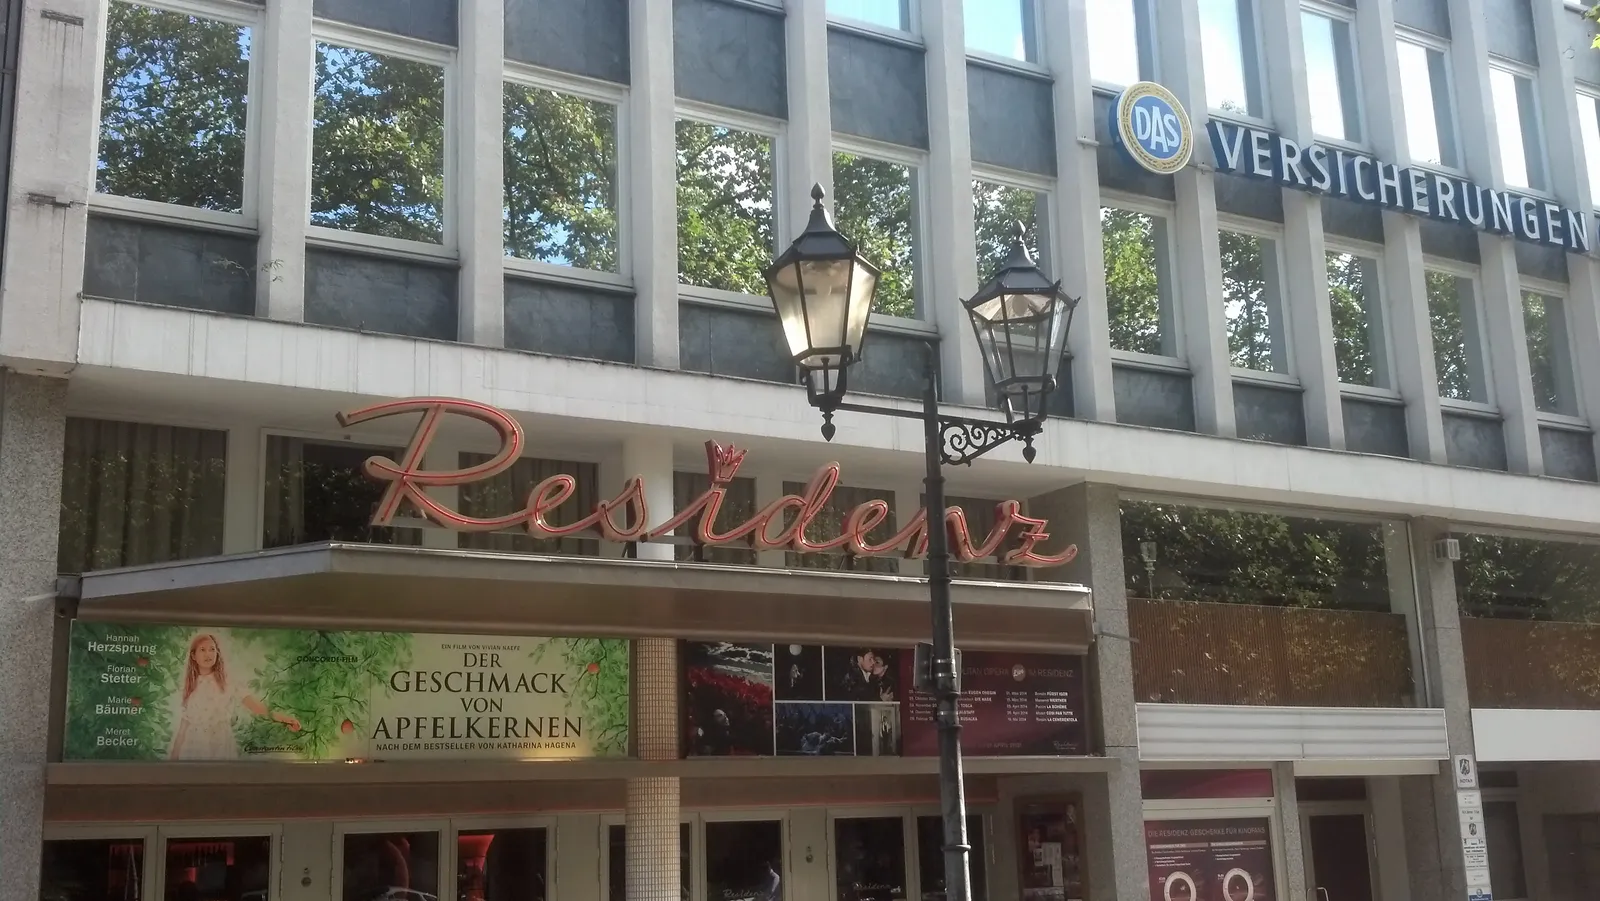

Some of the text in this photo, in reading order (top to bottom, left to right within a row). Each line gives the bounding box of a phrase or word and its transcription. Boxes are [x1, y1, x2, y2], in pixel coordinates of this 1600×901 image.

[1134, 105, 1180, 153] DAS
[1206, 121, 1590, 252] VERSICHERUNGEN
[338, 397, 1077, 567] Residenz
[106, 634, 140, 643] Hannah
[88, 641, 157, 655] Herzsprung
[463, 652, 503, 668] DER
[107, 665, 136, 673] Florian
[101, 673, 142, 684] Stetter
[390, 670, 569, 694] GESCHMACK
[107, 696, 132, 704] Marie
[460, 697, 503, 713] VON
[95, 704, 144, 716] Bäumer
[105, 727, 131, 736] Meret
[371, 716, 583, 740] APFELKERNEN
[97, 736, 139, 746] Becker
[376, 743, 401, 751] NACH
[403, 743, 421, 751] DEM
[424, 742, 476, 750] BESTSELLER
[497, 742, 542, 750] KATHARINA
[544, 742, 576, 750] HAGENA
